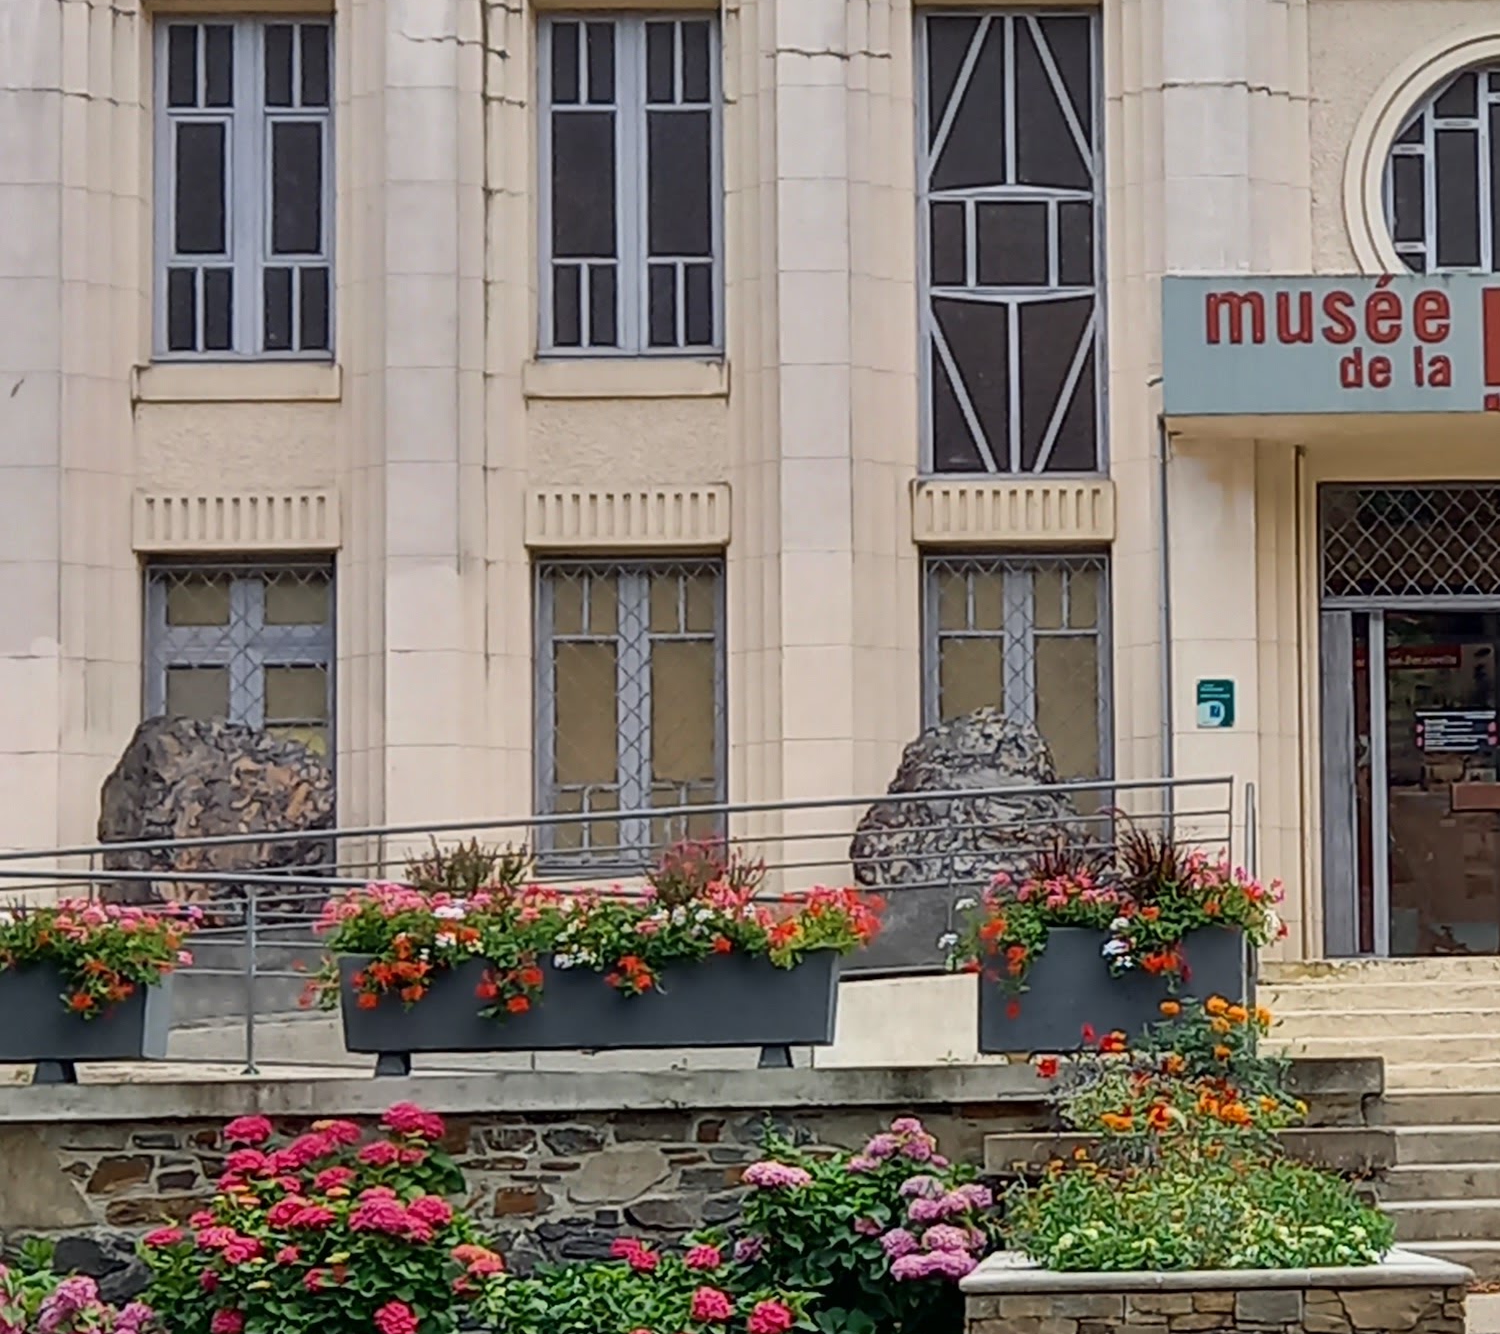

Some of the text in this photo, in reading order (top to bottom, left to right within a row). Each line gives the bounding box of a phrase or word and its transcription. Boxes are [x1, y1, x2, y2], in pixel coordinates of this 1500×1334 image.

[1205, 273, 1451, 345] musée
[1339, 345, 1453, 389] de la
